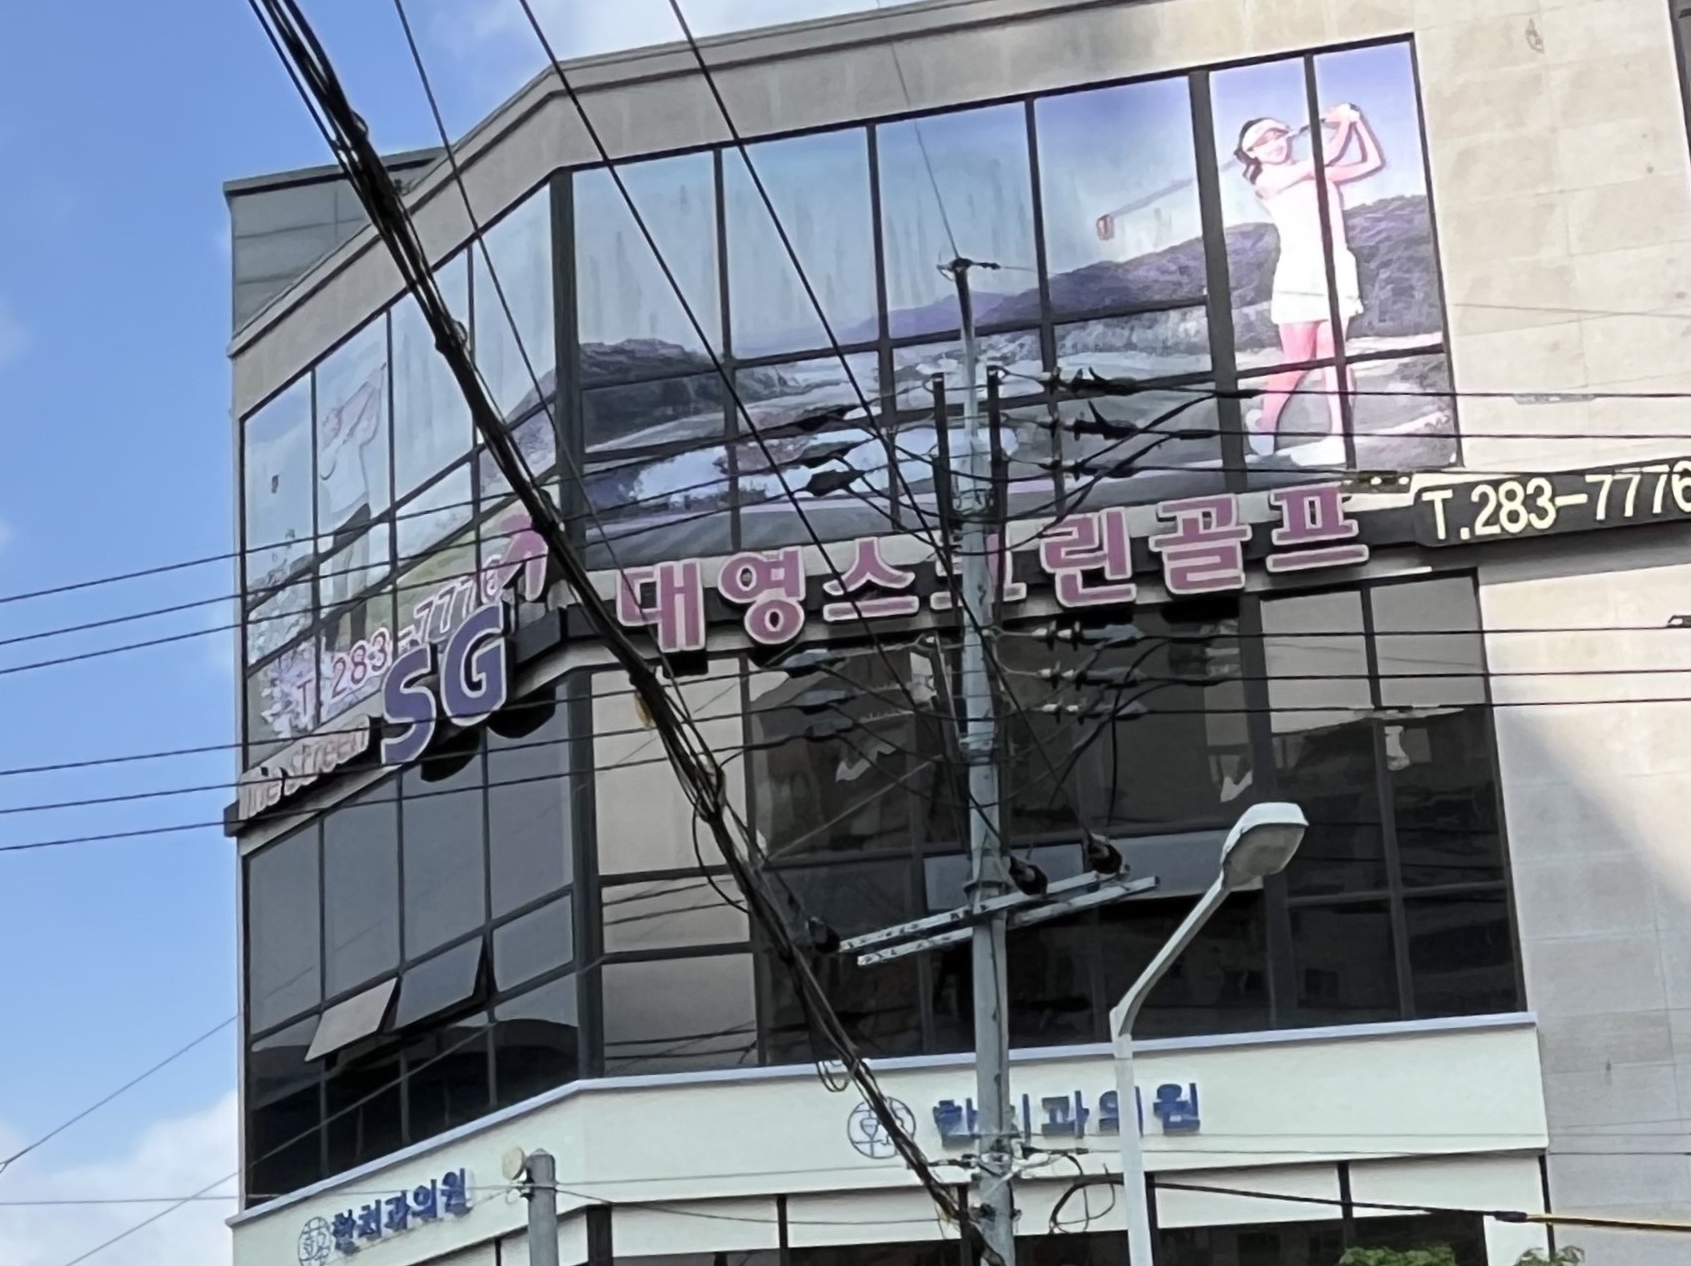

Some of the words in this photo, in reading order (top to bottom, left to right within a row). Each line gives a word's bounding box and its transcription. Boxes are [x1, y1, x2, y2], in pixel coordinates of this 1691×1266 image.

[1421, 460, 1691, 541] T.283-7776
[380, 599, 508, 766] SG
[932, 1082, 1201, 1149] 한과의원
